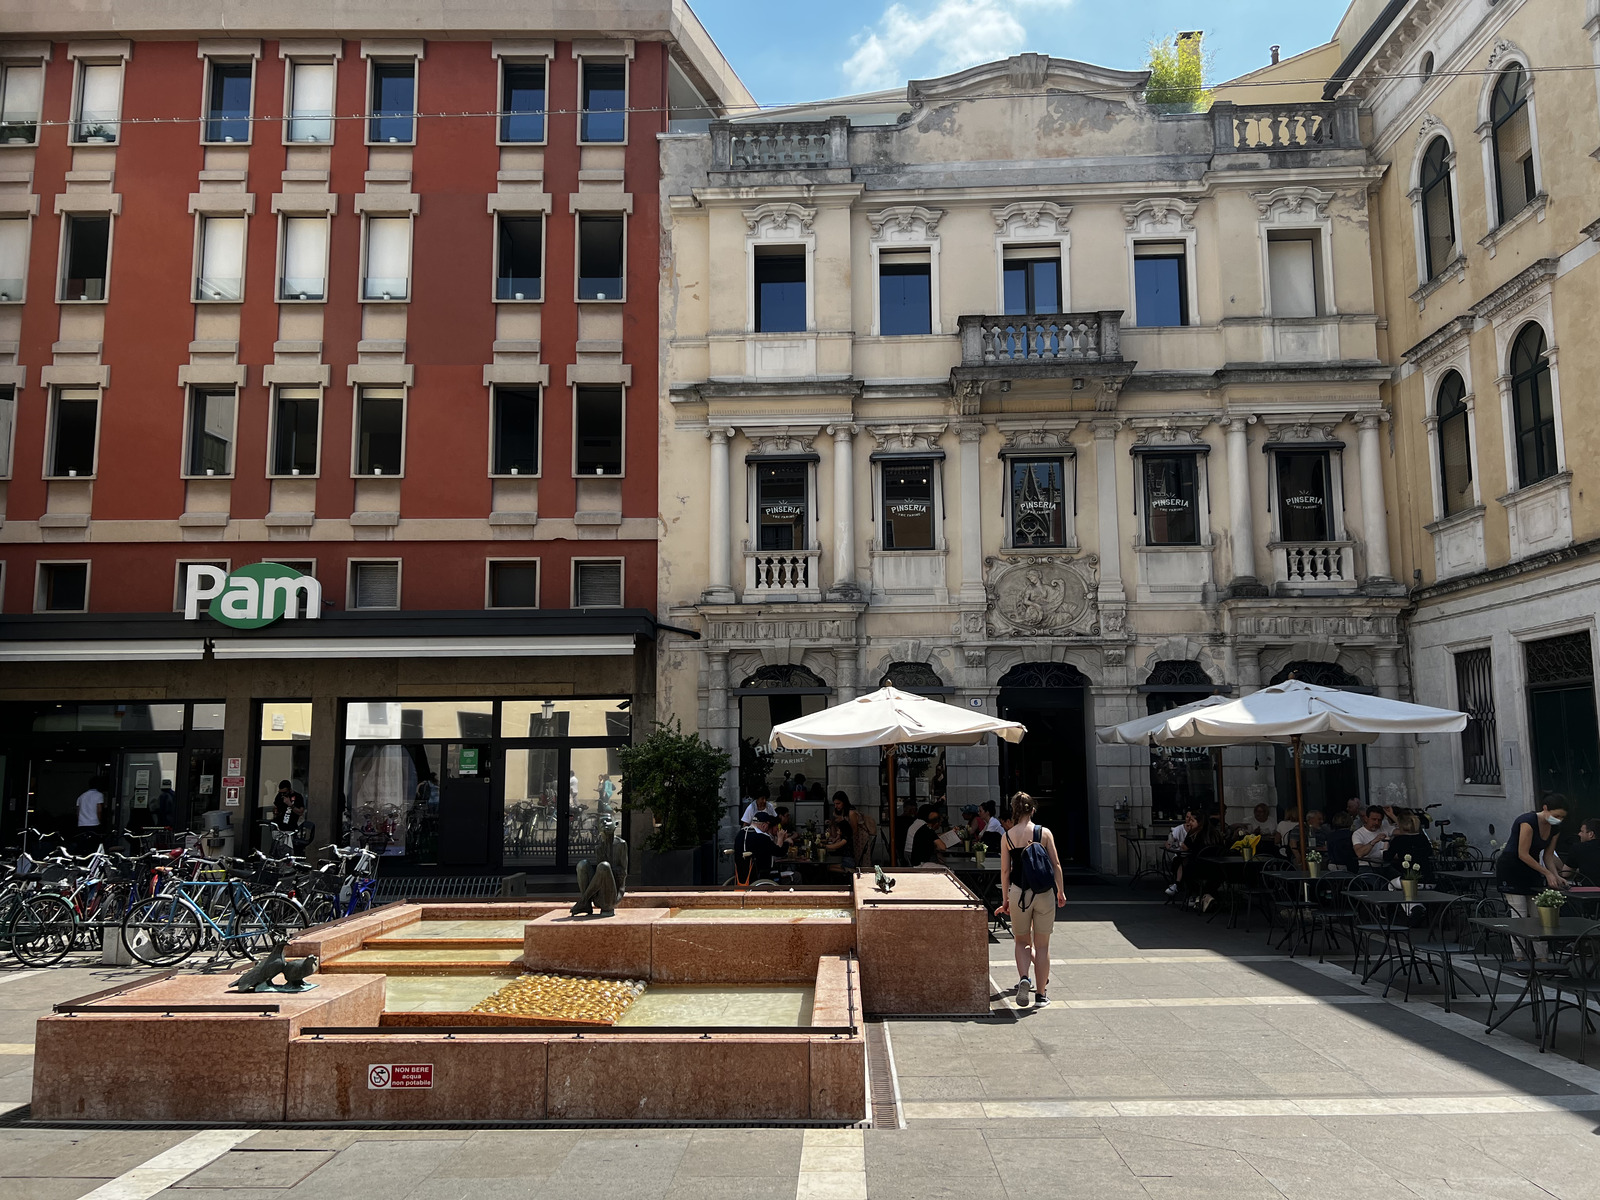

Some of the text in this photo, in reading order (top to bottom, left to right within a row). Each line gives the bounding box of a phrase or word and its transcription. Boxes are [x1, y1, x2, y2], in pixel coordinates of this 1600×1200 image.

[1152, 499, 1189, 508] PINSERIA
[1286, 496, 1323, 505] PINSERIA
[765, 505, 800, 515] PINSERIA
[891, 504, 926, 514] PINSERIA
[1020, 501, 1056, 511] PINSERIA
[184, 564, 322, 620] Pam
[1287, 743, 1351, 758] PNSERIA
